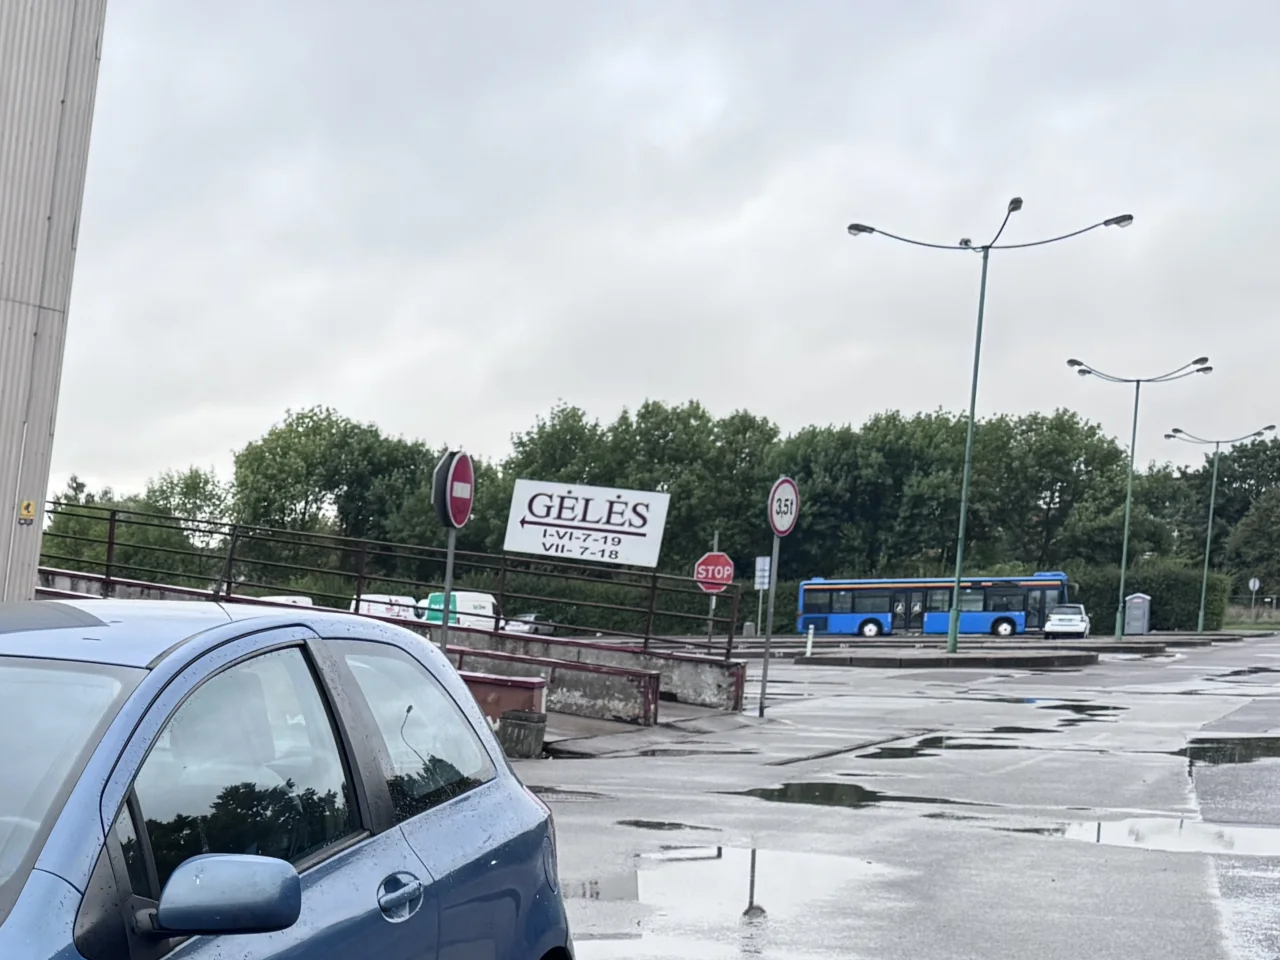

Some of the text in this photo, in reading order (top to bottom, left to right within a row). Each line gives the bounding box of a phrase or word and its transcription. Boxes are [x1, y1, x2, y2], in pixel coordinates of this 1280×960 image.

[527, 490, 650, 529] GĖLĖS
[542, 528, 622, 547] I-VI-7-19
[697, 565, 733, 579] STOP
